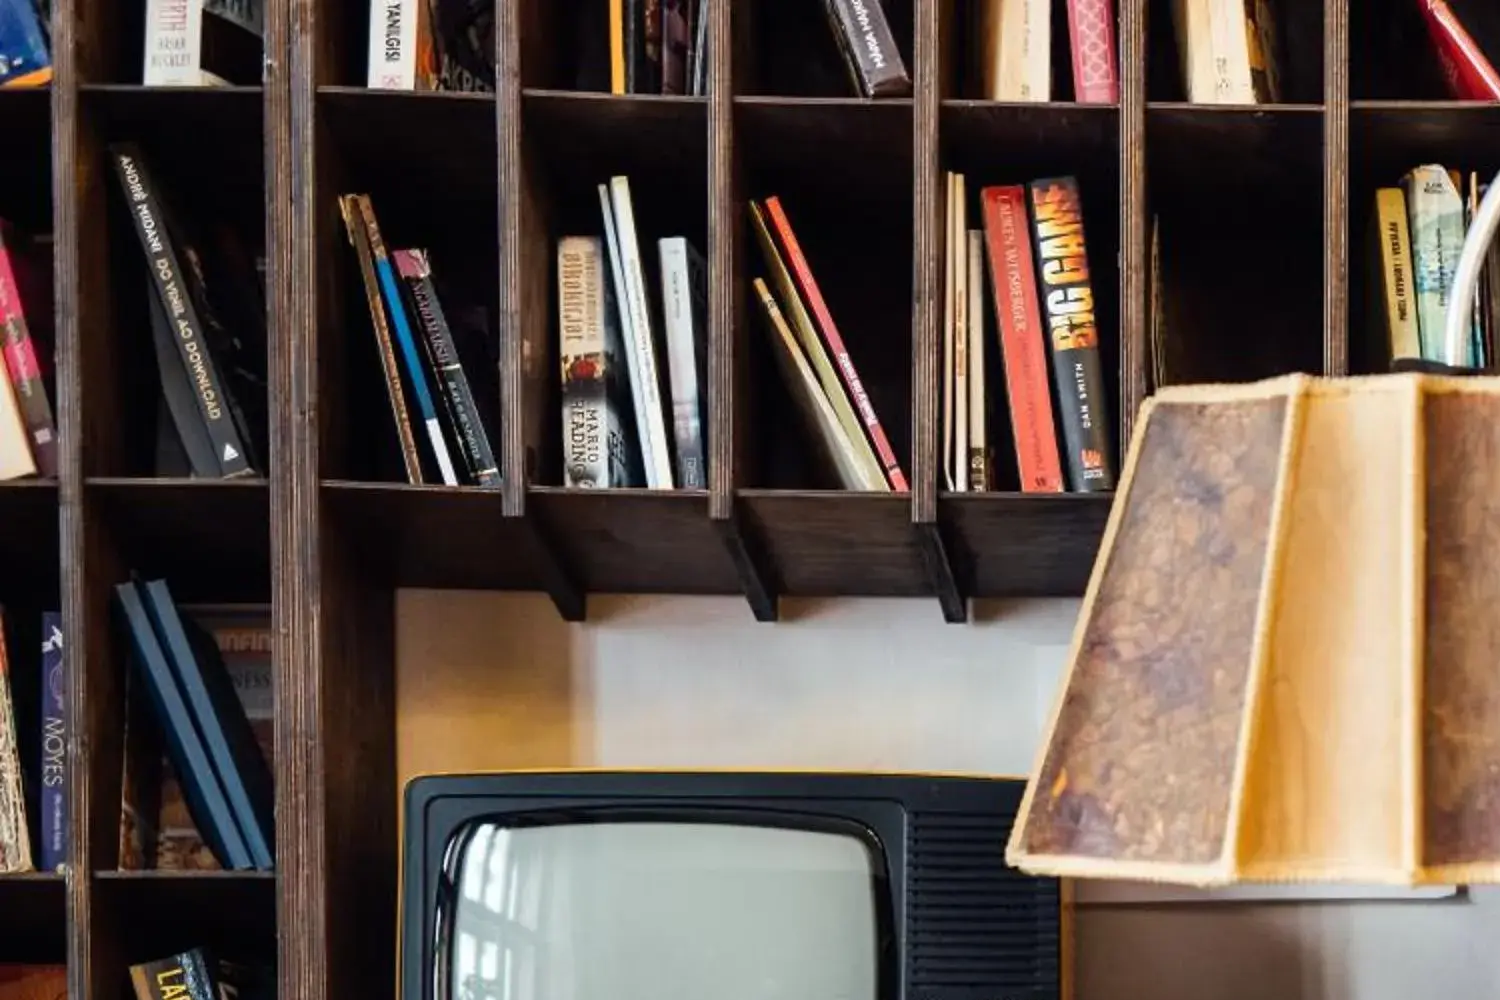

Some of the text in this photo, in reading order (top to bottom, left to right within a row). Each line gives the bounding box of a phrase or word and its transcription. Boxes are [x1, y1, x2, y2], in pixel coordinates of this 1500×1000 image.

[184, 341, 222, 420] DOWNLOAD
[570, 400, 584, 475] READING
[587, 409, 598, 463] MARIO
[44, 717, 65, 786] MOYES
